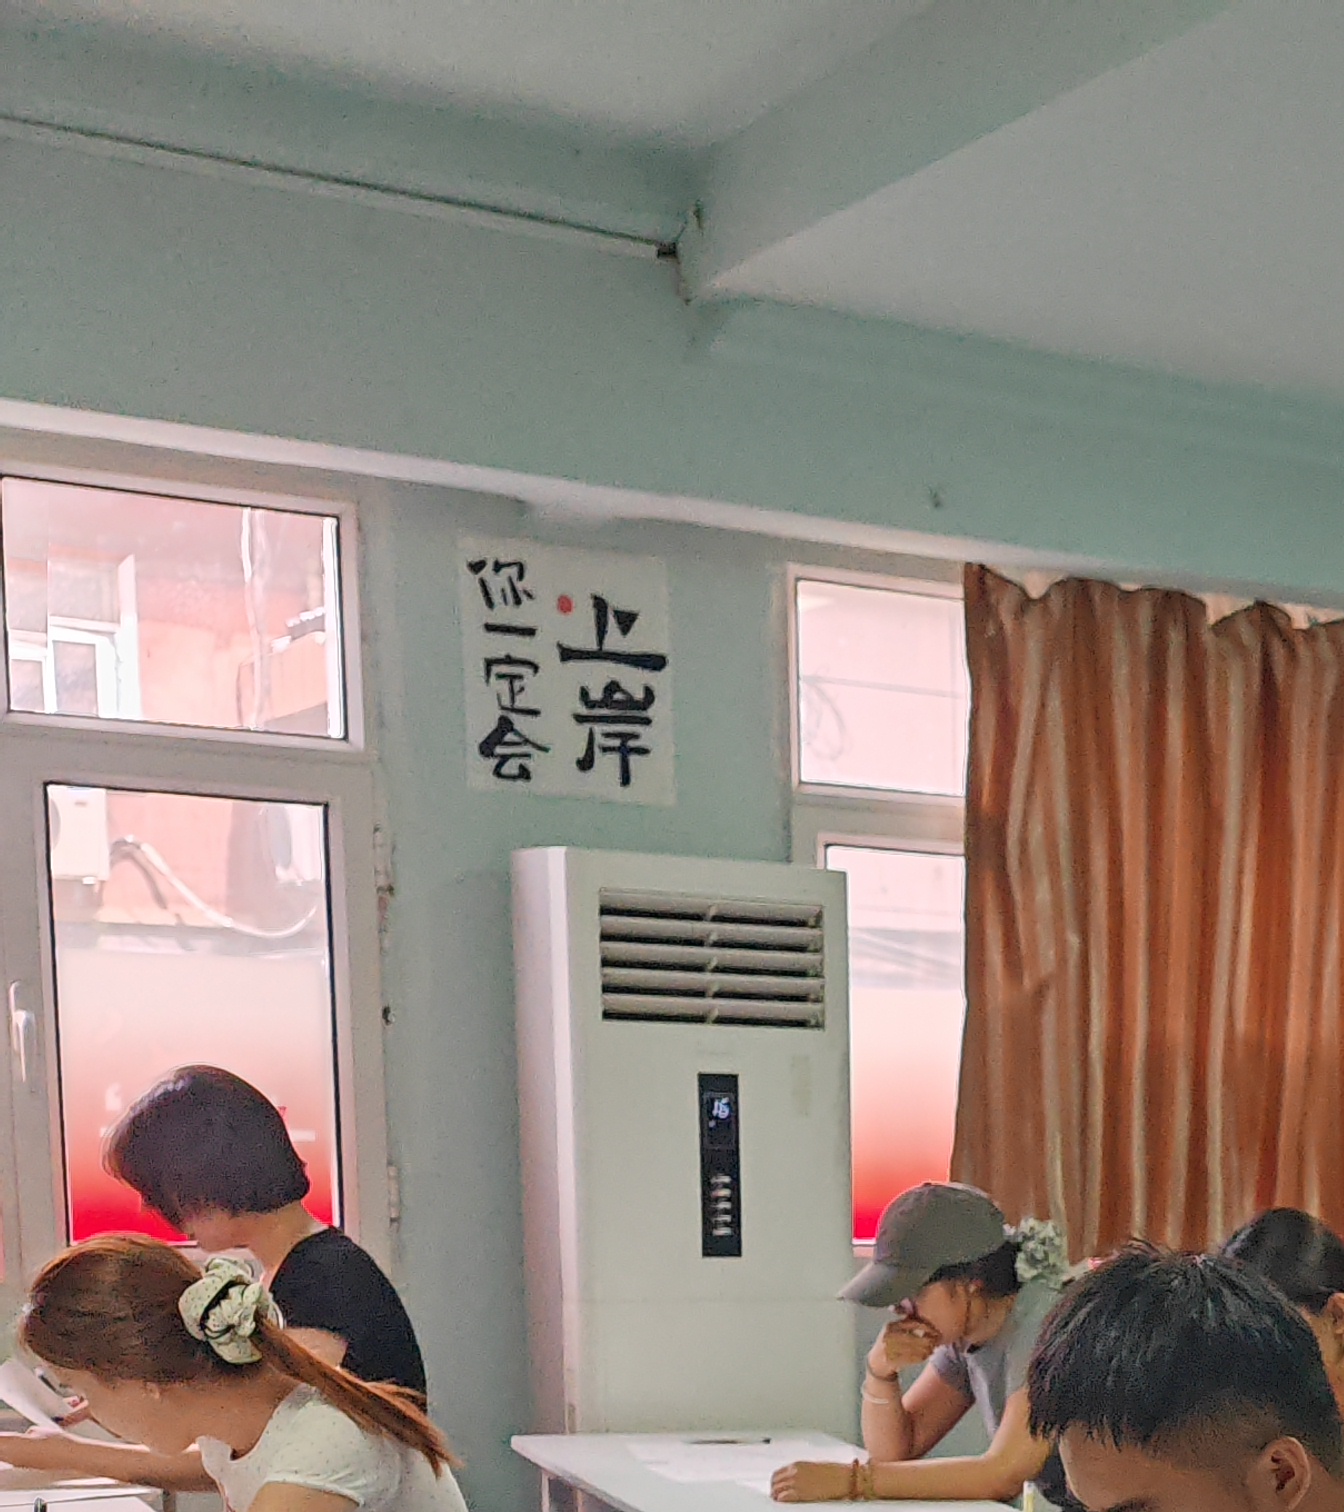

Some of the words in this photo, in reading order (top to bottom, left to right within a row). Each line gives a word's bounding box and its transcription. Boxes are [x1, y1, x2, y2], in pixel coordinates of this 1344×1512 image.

[466, 557, 551, 781] 你一定会
[556, 592, 668, 788] 上岸
